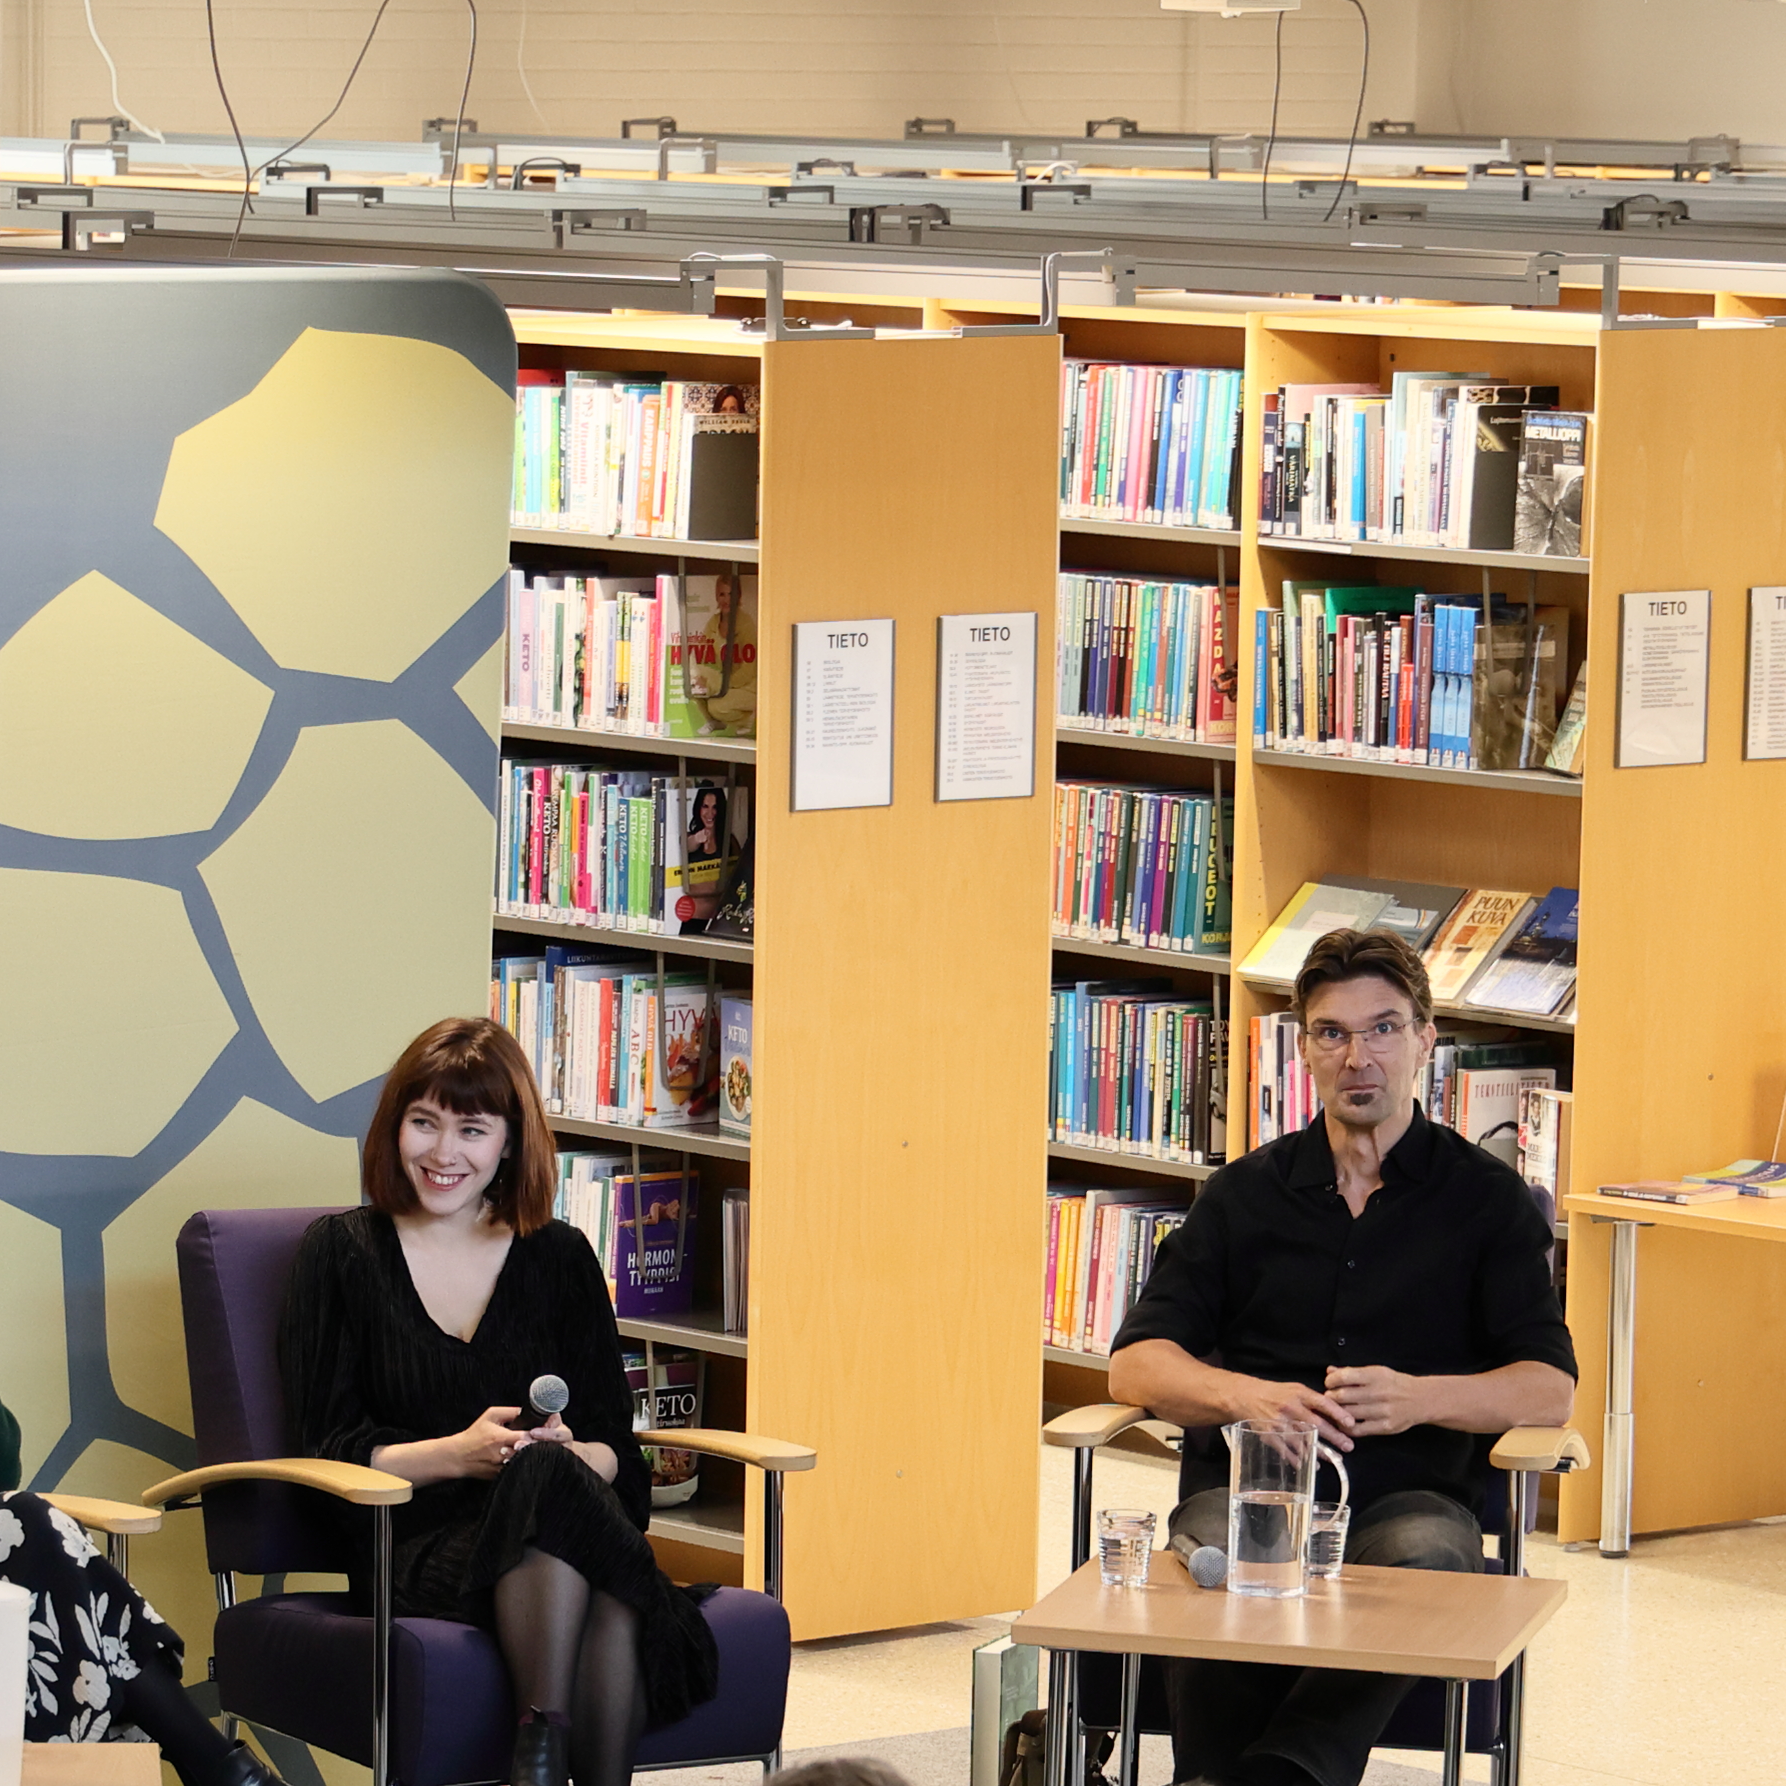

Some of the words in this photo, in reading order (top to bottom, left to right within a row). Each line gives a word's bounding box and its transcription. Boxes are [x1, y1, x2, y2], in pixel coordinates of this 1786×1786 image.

[641, 408, 655, 468] KARPPAUS
[1648, 601, 1687, 616] TIETO
[827, 633, 869, 648] TIETO
[970, 626, 1011, 642] TIETO
[522, 633, 530, 672] KETO
[543, 801, 551, 834] KETO
[619, 804, 627, 833] KETO
[630, 806, 638, 834] KETO
[640, 807, 648, 836] KETO
[1472, 896, 1519, 911] PUUN
[1467, 910, 1507, 926] KUVA
[630, 1029, 641, 1066] ABC
